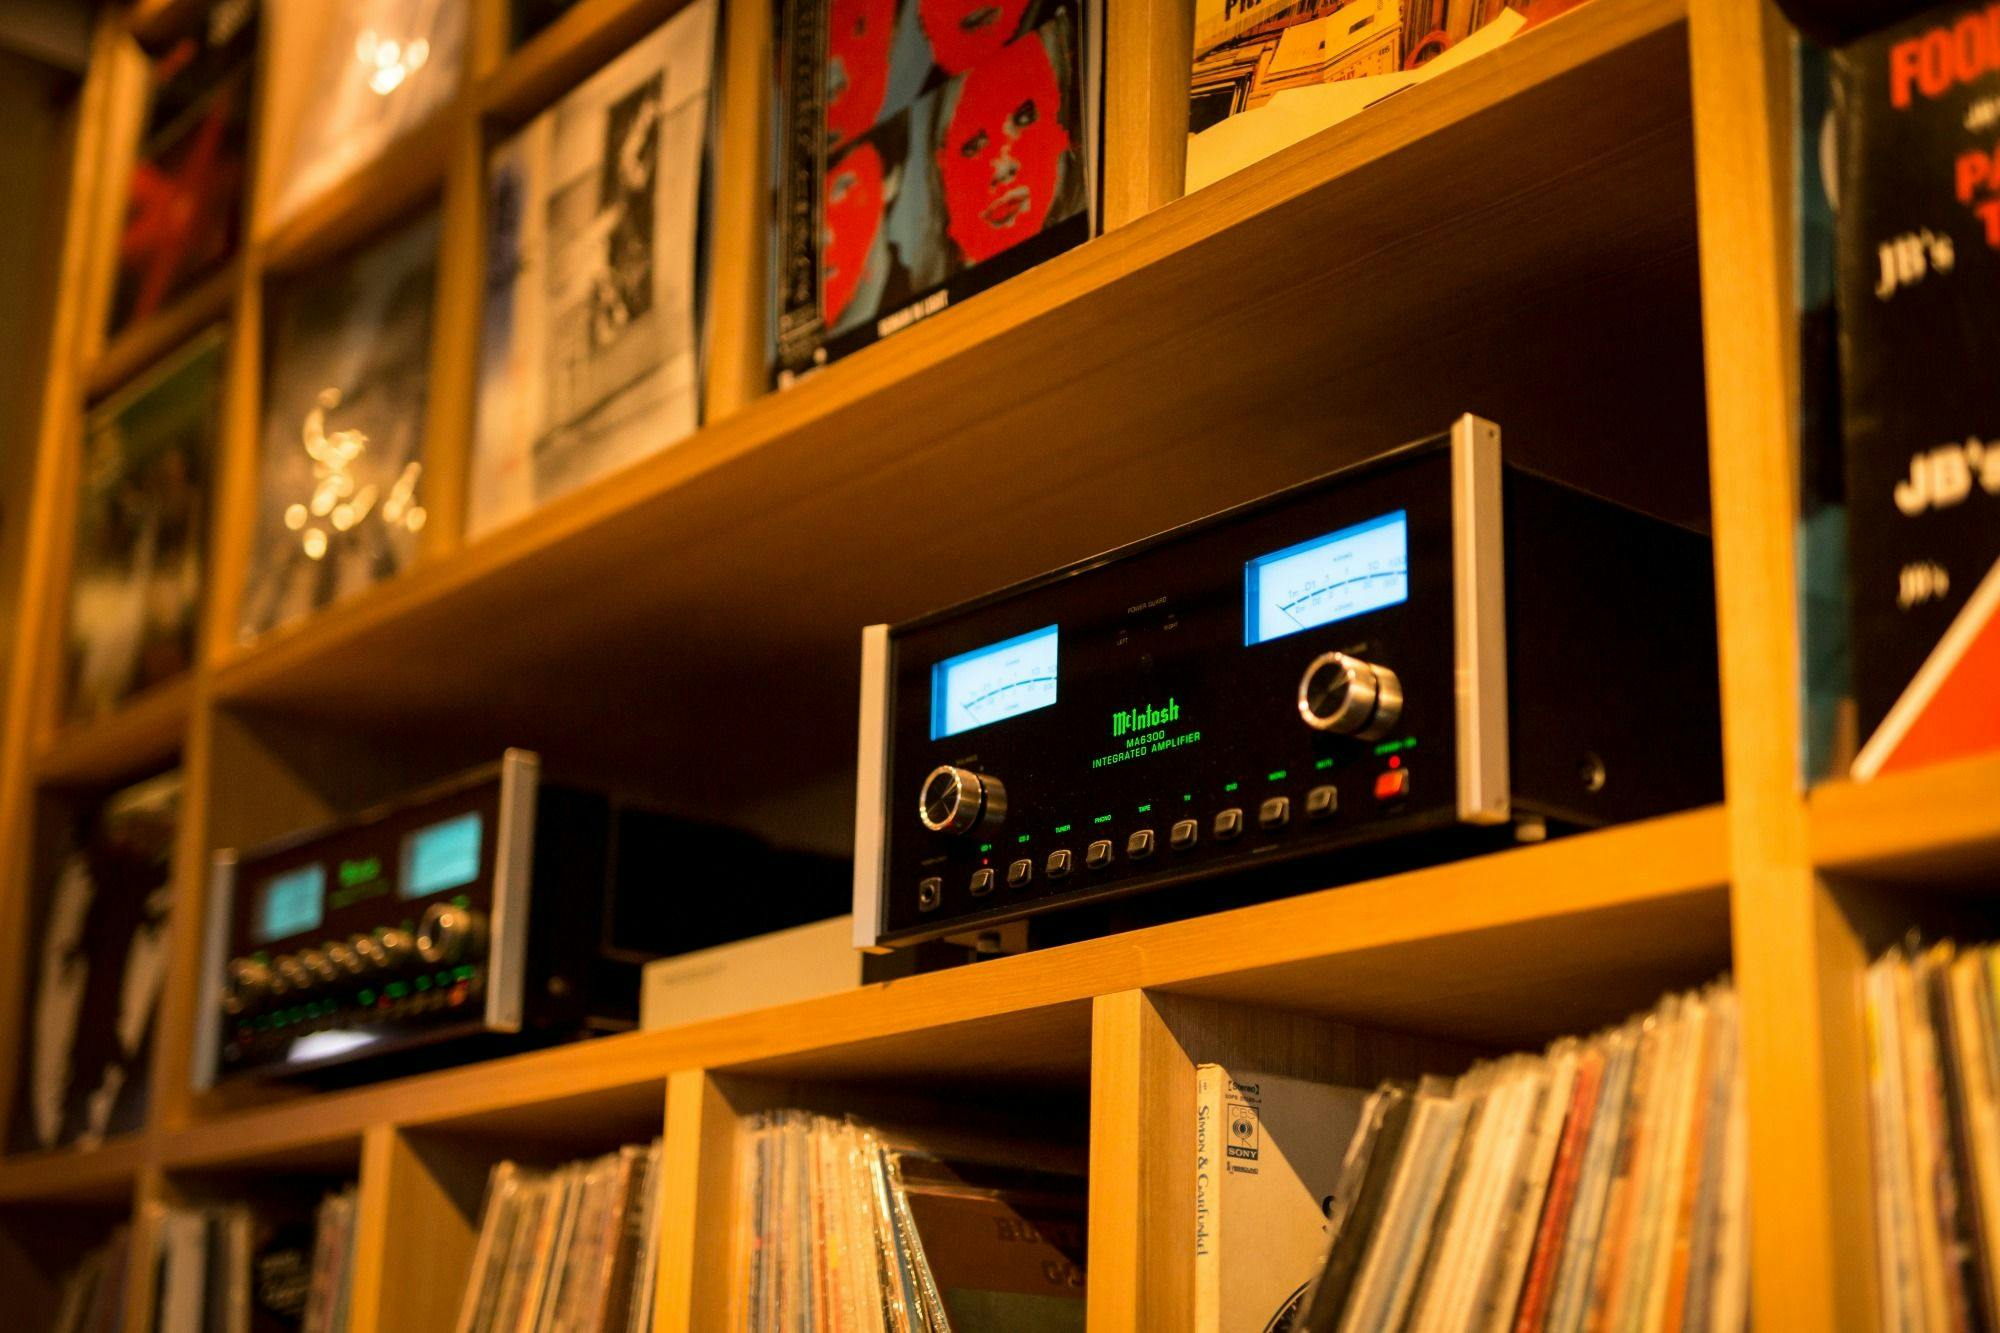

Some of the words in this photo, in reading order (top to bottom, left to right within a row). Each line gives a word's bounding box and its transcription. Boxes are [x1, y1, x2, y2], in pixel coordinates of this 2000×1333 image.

[1112, 697, 1179, 737] McIntosh
[1126, 730, 1165, 748] MA6300
[1092, 746, 1147, 769] INTEGRATED
[1151, 731, 1201, 753] AMPLIFIER
[1231, 1107, 1255, 1120] CBS
[1228, 1148, 1257, 1159] SONY
